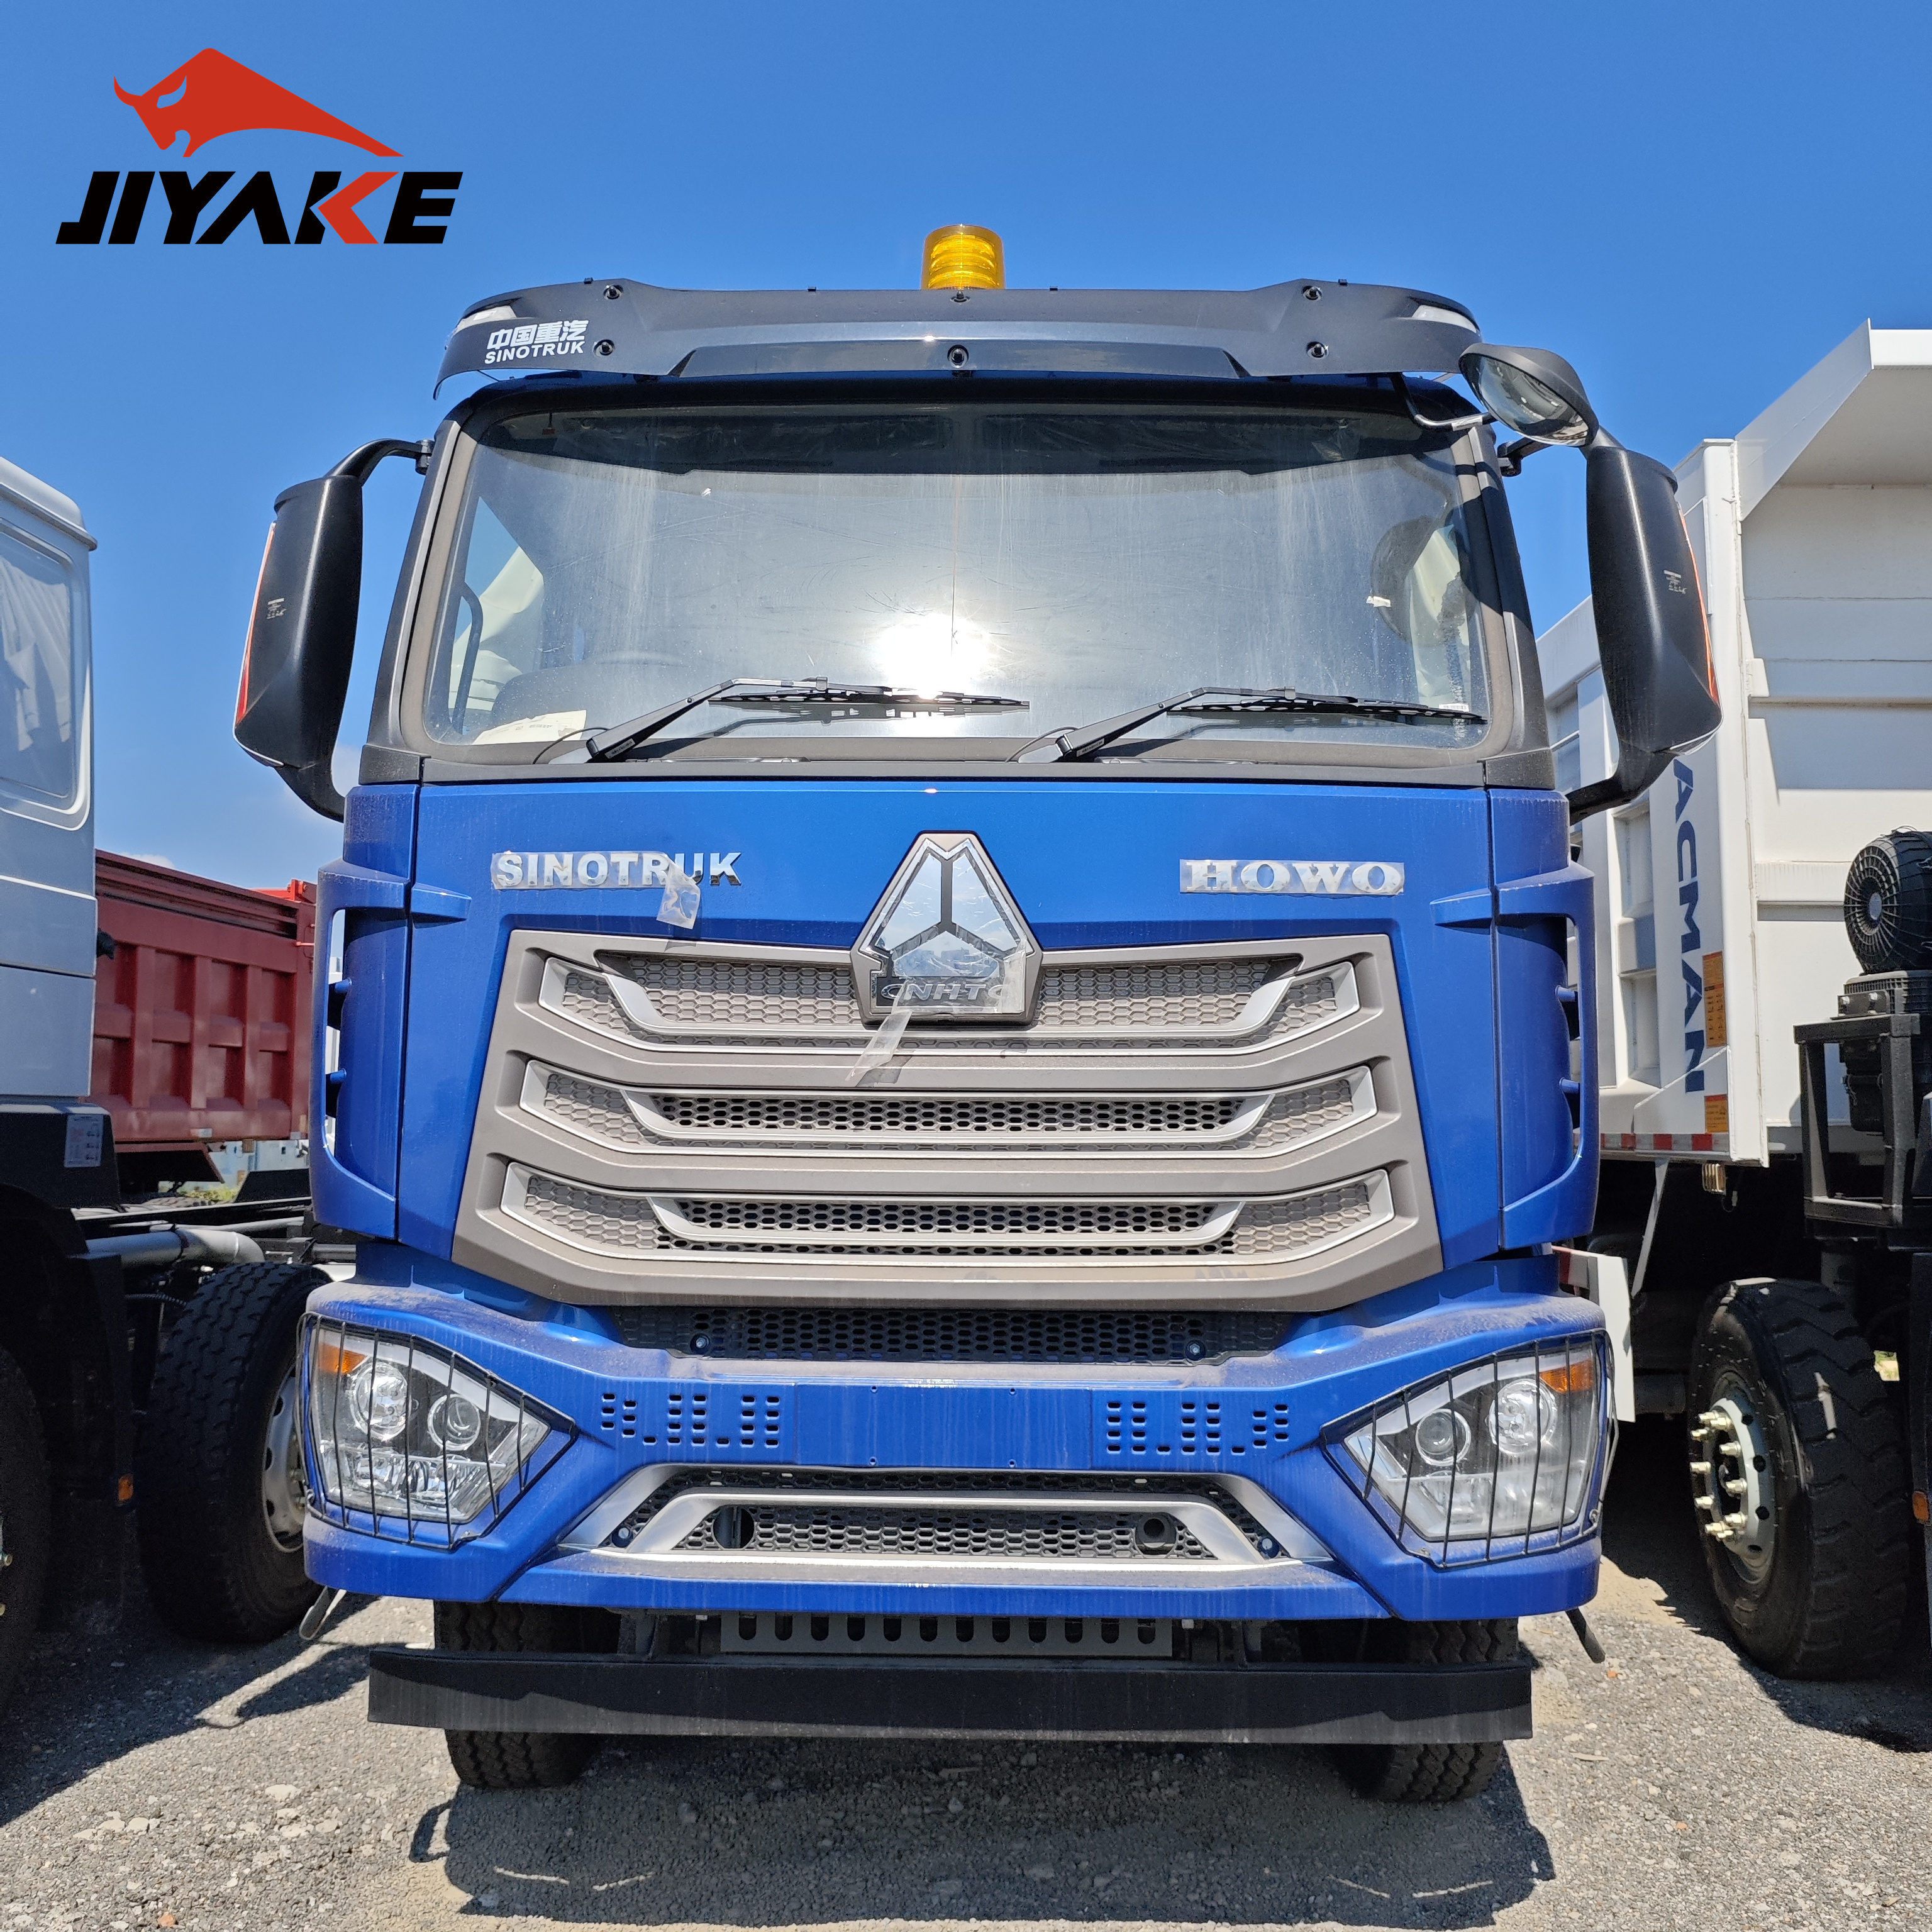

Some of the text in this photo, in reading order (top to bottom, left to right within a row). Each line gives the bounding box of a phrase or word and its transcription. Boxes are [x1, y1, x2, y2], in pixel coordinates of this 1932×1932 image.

[486, 319, 589, 350] 中国重汽
[484, 341, 585, 364] SINOTRUK
[497, 852, 742, 887] SINOTRUK
[1185, 861, 1402, 894] HOWO
